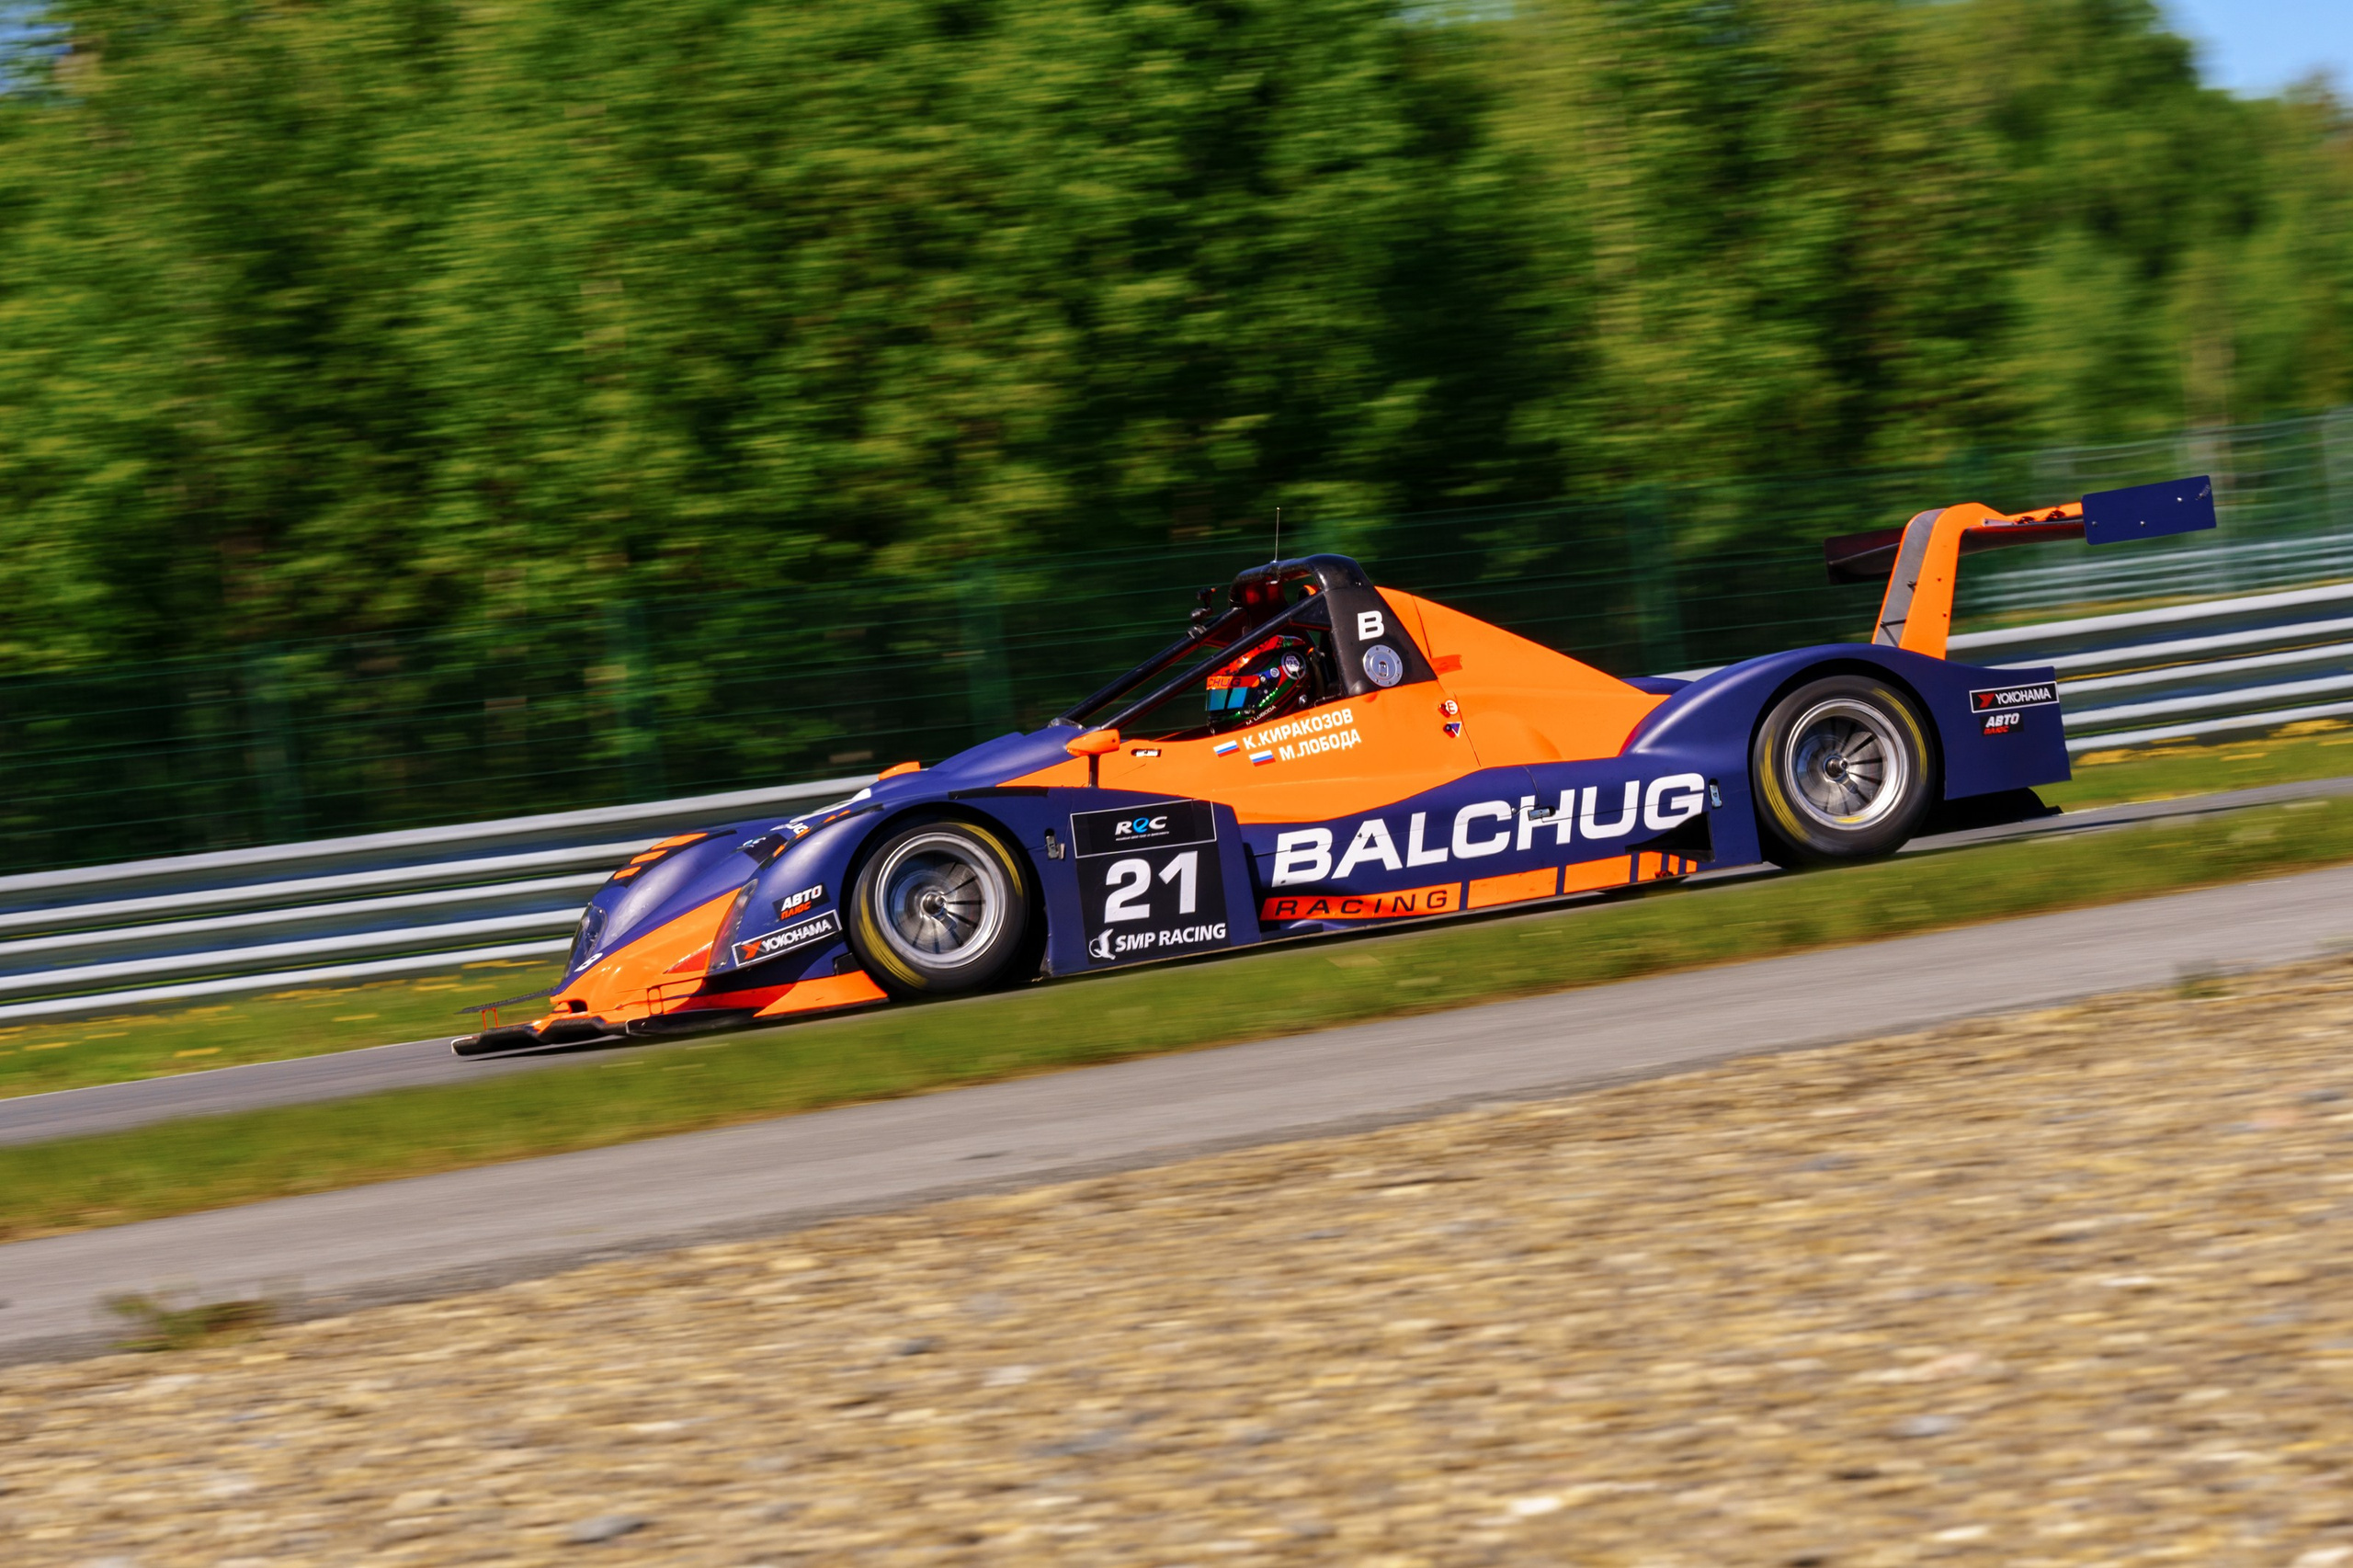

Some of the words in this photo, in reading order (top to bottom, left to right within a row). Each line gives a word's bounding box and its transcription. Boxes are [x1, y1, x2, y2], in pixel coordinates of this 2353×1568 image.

[1358, 610, 1385, 641] B
[1447, 701, 1456, 712] E
[1995, 687, 2052, 705] YOKOHAMA
[1243, 708, 1353, 750] К.КИРАКОЗОВ
[1985, 712, 2019, 728] АВТО
[1279, 728, 1361, 761] М.ЛОБОДА
[1271, 773, 1705, 888] BALCHUG
[780, 884, 823, 912] АВТО
[1104, 850, 1198, 924] 21
[1275, 890, 1448, 916] RACING
[761, 919, 833, 952] YOKOHAMA
[1115, 931, 1155, 953] SMP
[1158, 923, 1226, 946] RACING
